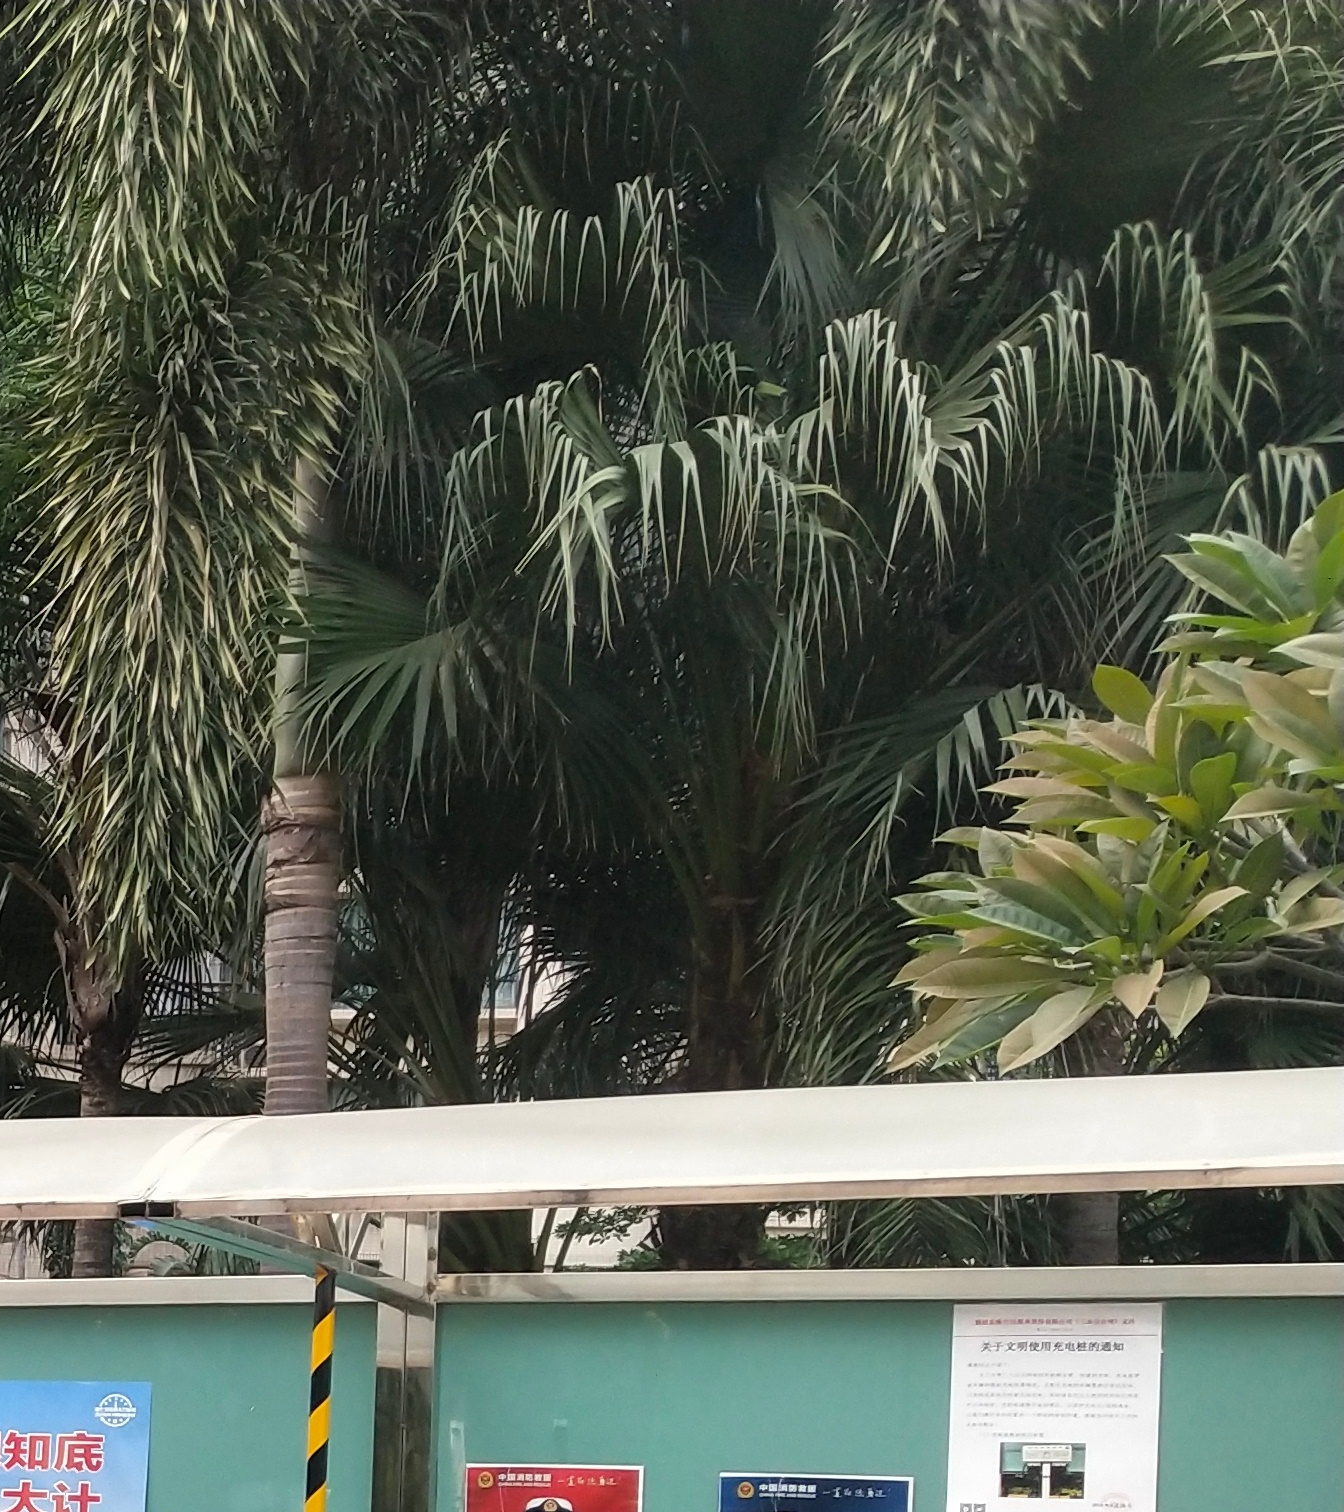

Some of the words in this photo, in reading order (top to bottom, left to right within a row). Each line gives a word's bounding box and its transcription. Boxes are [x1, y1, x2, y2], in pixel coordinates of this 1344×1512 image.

[981, 1341, 1124, 1352] 关于文明使用充电桩的通知
[498, 1472, 552, 1482] 中国消防救援
[759, 1483, 817, 1493] 中国消防救援
